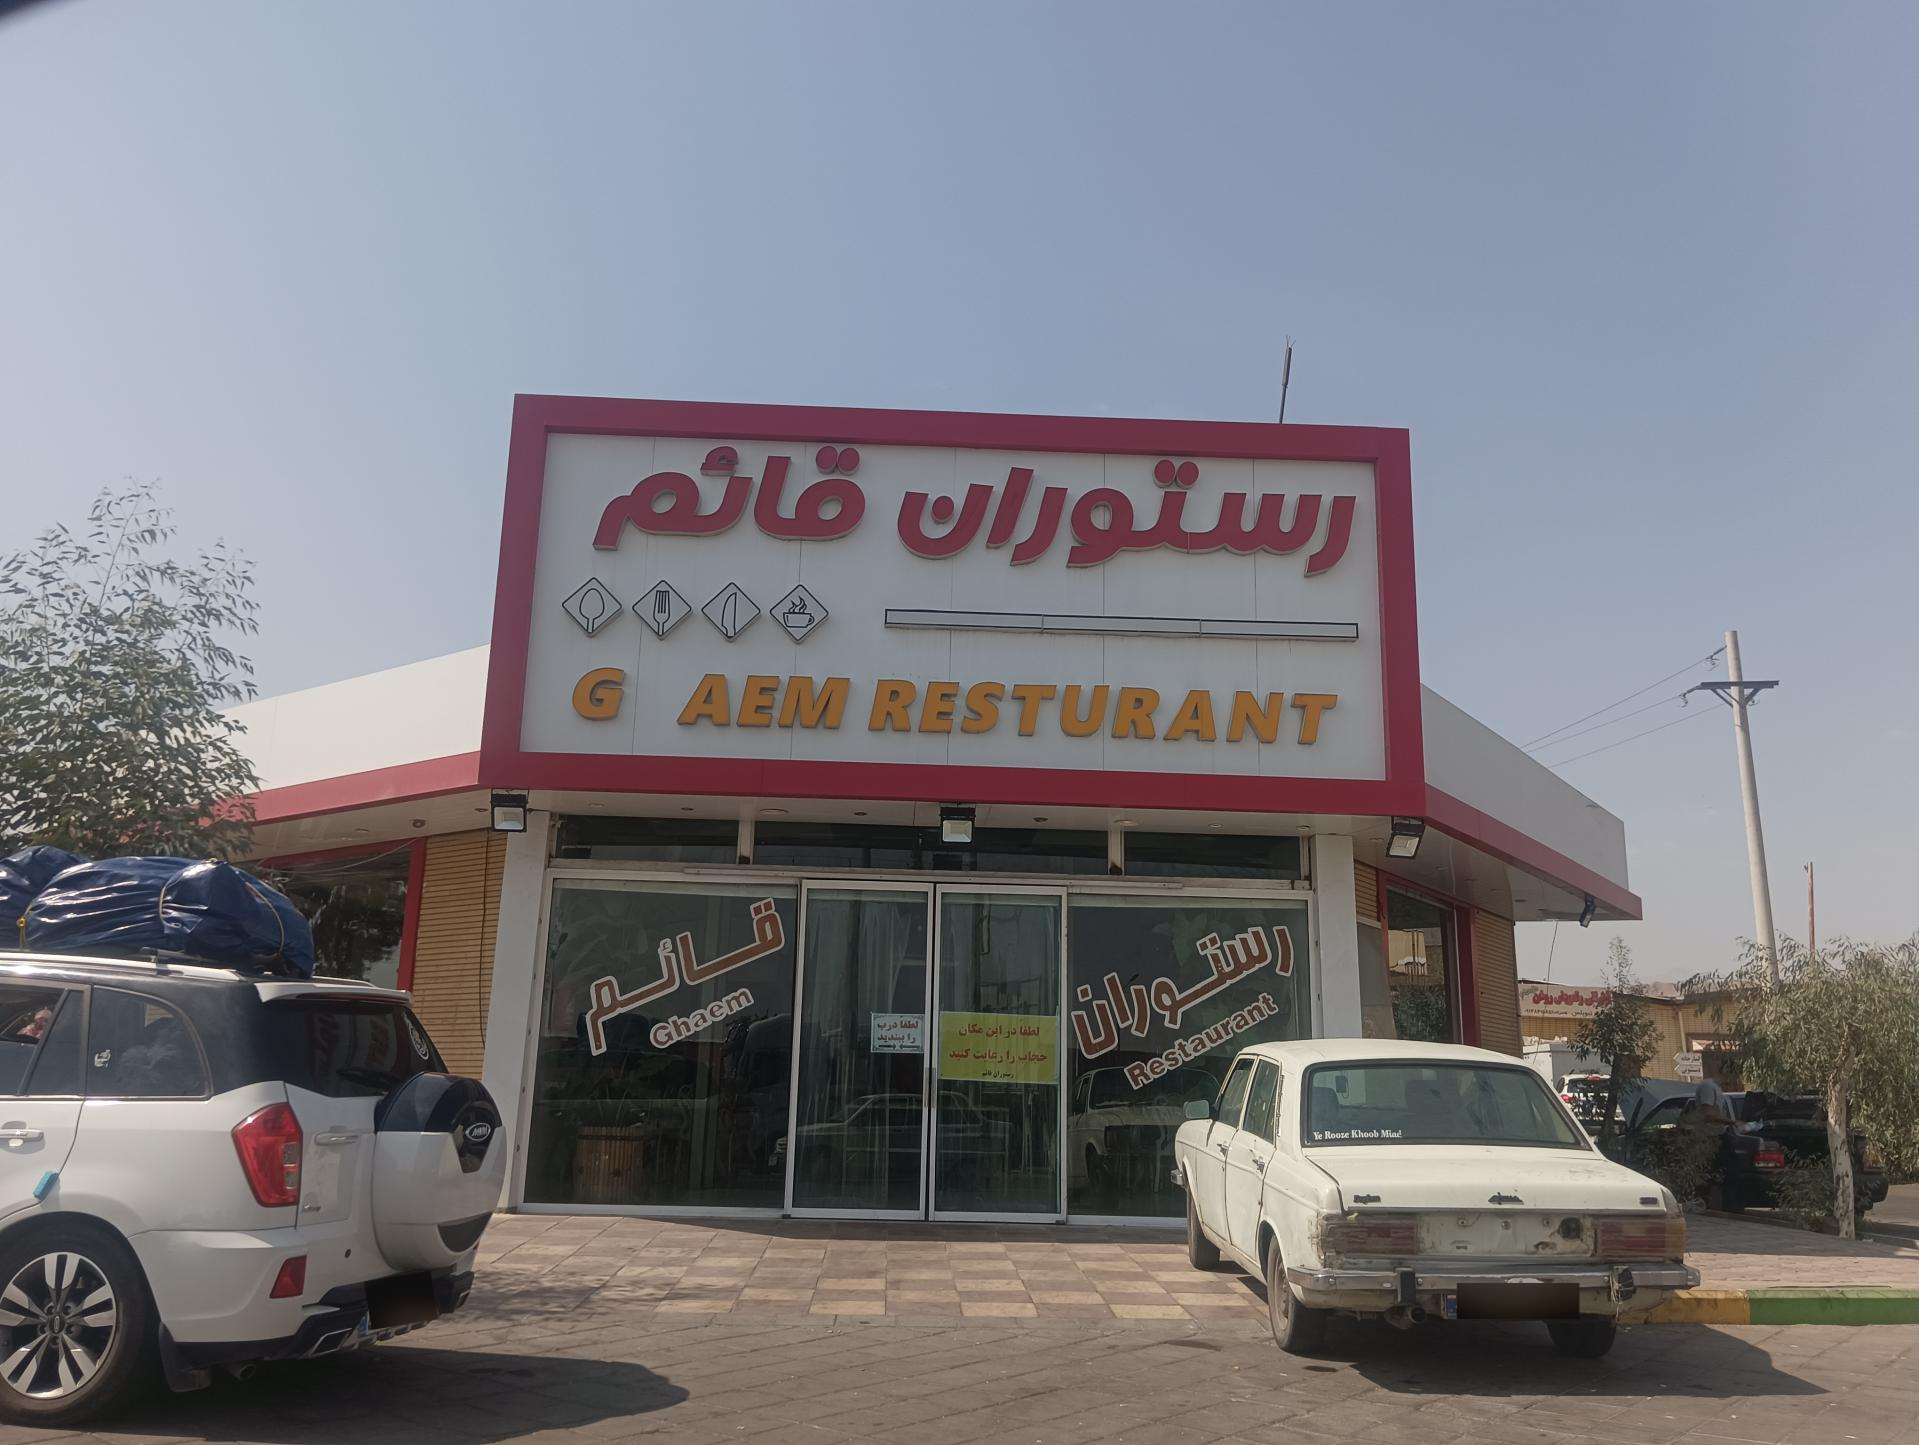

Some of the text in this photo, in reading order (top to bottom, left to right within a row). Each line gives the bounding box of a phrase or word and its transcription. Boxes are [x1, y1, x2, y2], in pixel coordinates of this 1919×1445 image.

[592, 446, 1357, 577] رستوران قائم
[677, 673, 851, 729] AEM
[868, 679, 1338, 745] RESTURANT
[586, 898, 785, 1056] قائم
[1071, 926, 1293, 1059] رستوران
[650, 988, 754, 1048] Ghaem
[877, 1021, 898, 1031] درب
[906, 1033, 916, 1043] را
[959, 1024, 984, 1036] مکان
[985, 1025, 1002, 1039] این
[1005, 1028, 1017, 1038] در
[1124, 993, 1278, 1090] Restaurant
[949, 1048, 1048, 1064] حجاب را رعایت کنید
[1313, 1131, 1323, 1140] Ye
[1324, 1130, 1350, 1140] Rooze
[1351, 1129, 1379, 1139] Khoob
